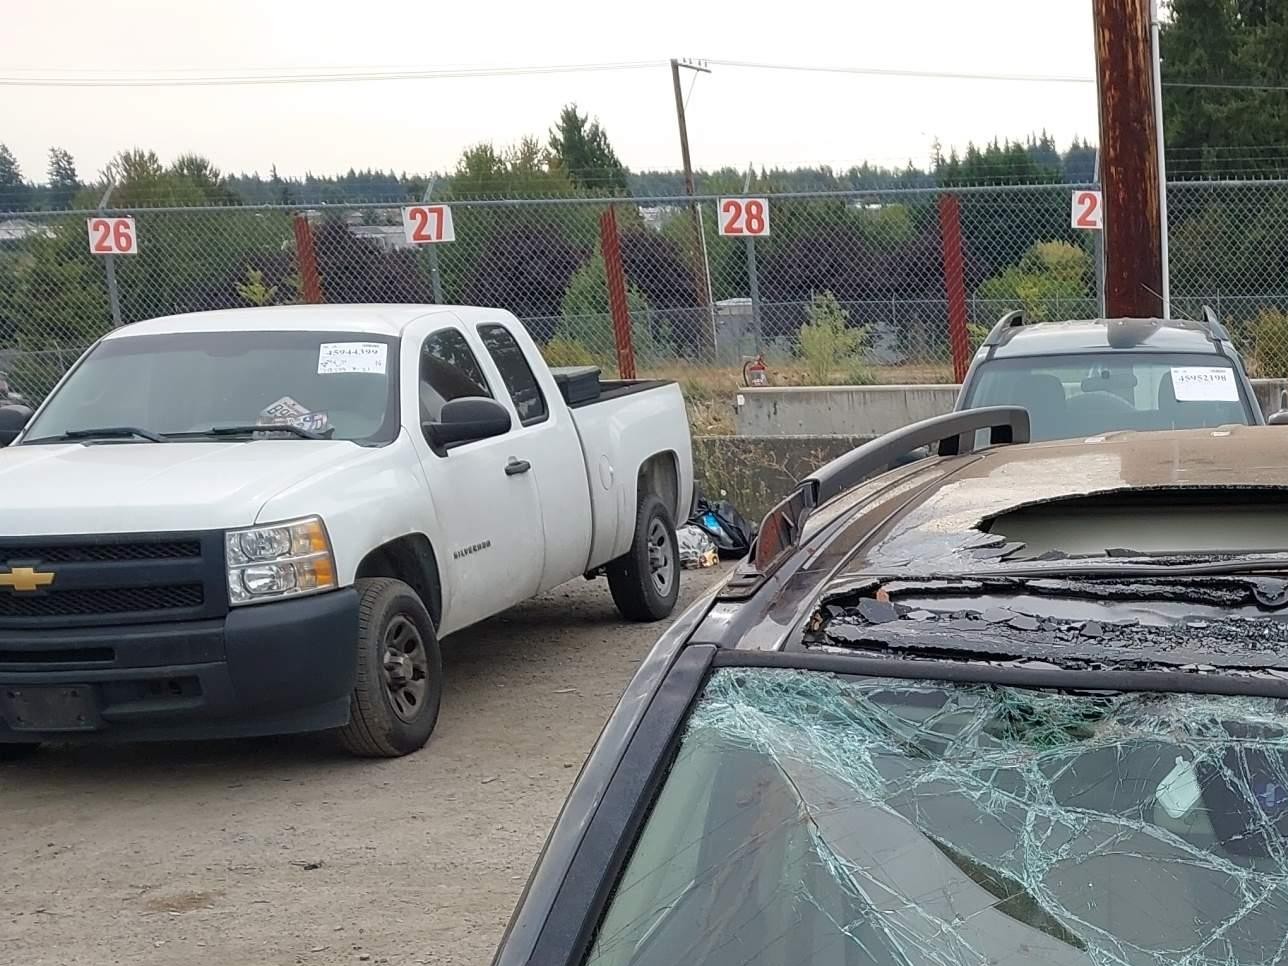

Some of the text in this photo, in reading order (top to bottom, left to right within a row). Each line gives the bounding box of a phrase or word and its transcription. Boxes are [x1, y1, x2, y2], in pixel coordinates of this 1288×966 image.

[408, 206, 444, 242] 27
[722, 199, 765, 234] 28
[1076, 192, 1102, 227] 2
[92, 219, 133, 252] 26
